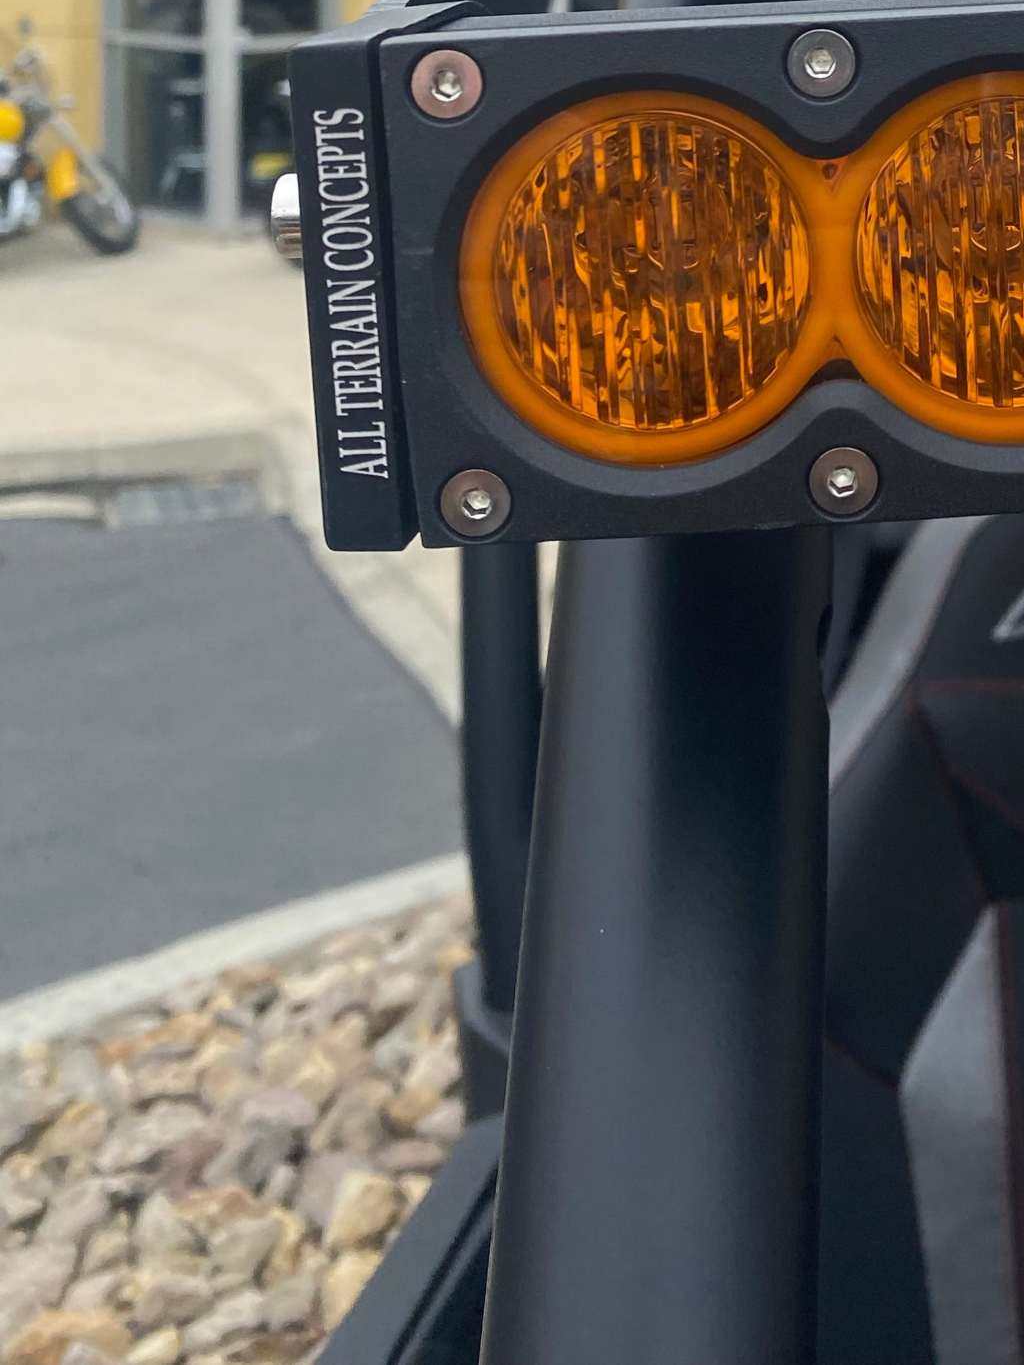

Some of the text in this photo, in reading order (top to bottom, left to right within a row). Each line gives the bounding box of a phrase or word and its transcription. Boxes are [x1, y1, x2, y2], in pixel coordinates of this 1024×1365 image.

[313, 107, 389, 479] ALL TERRAIN CONCEPTS
